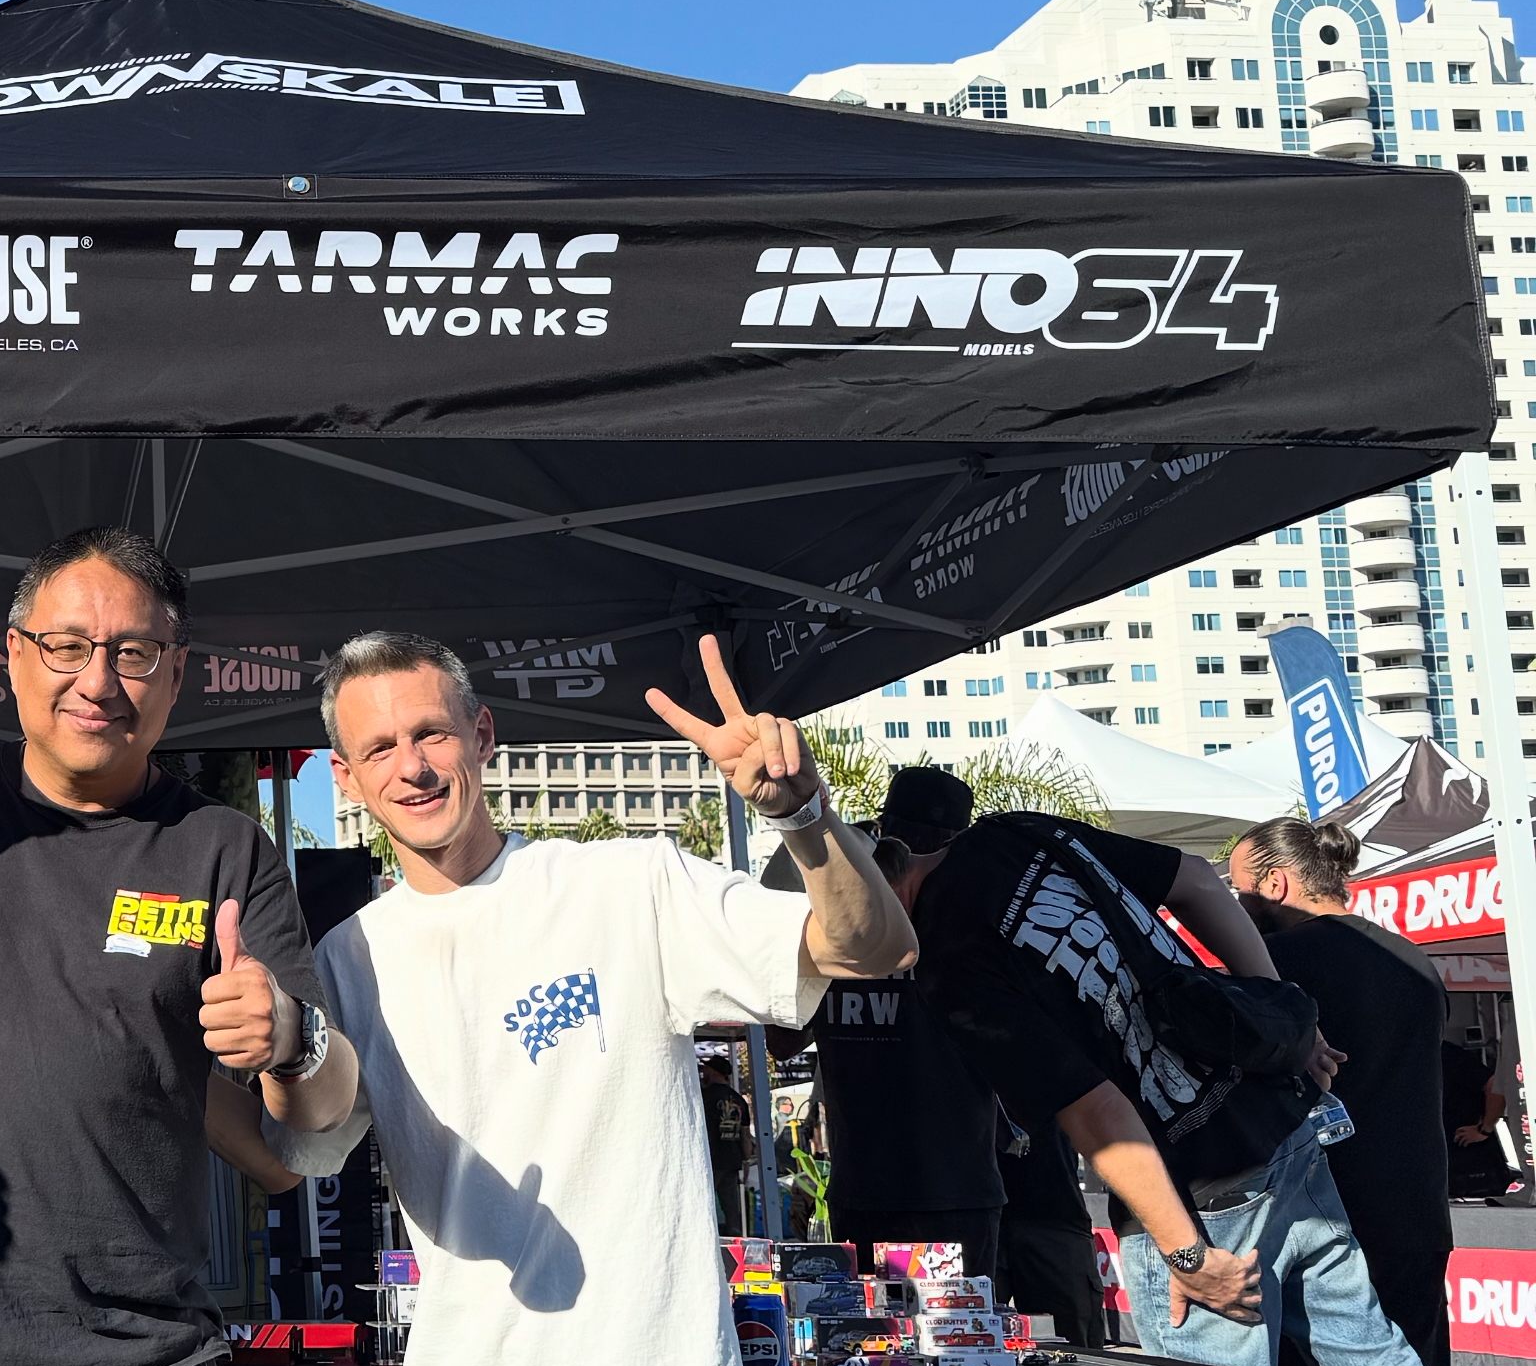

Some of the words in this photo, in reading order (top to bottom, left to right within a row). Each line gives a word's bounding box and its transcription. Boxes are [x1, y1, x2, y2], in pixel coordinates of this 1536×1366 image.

[174, 229, 620, 295] TARMAC
[383, 306, 609, 337] WORKS
[50, 339, 79, 351] CA
[963, 343, 1035, 357] MODELS
[112, 896, 210, 924] PETIT
[1346, 885, 1401, 935] AR
[740, 1343, 778, 1356] EPSI
